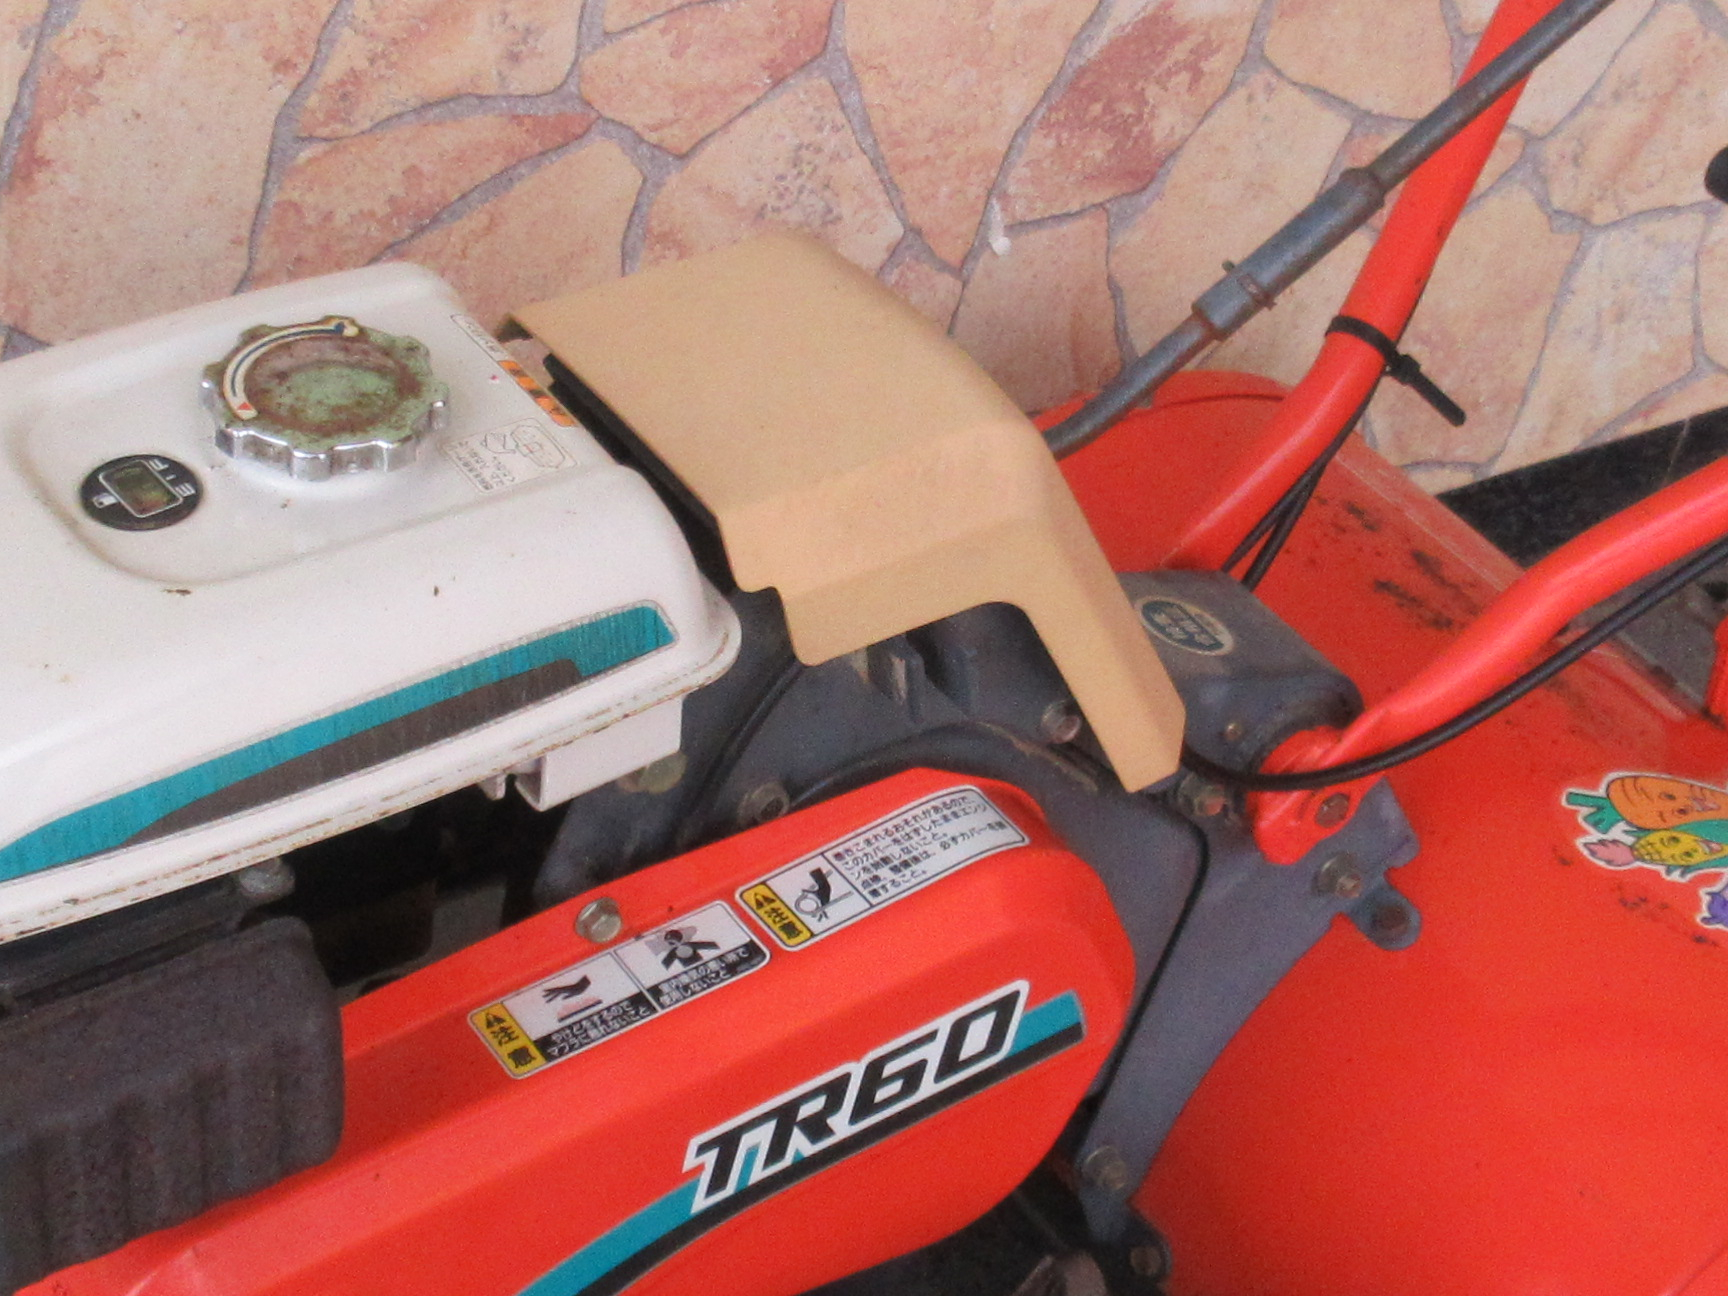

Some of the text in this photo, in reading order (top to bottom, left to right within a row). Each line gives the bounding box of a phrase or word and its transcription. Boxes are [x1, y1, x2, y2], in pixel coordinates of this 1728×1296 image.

[764, 907, 804, 940] 注意
[489, 1024, 537, 1069] 注意
[690, 985, 1024, 1204] TR60
